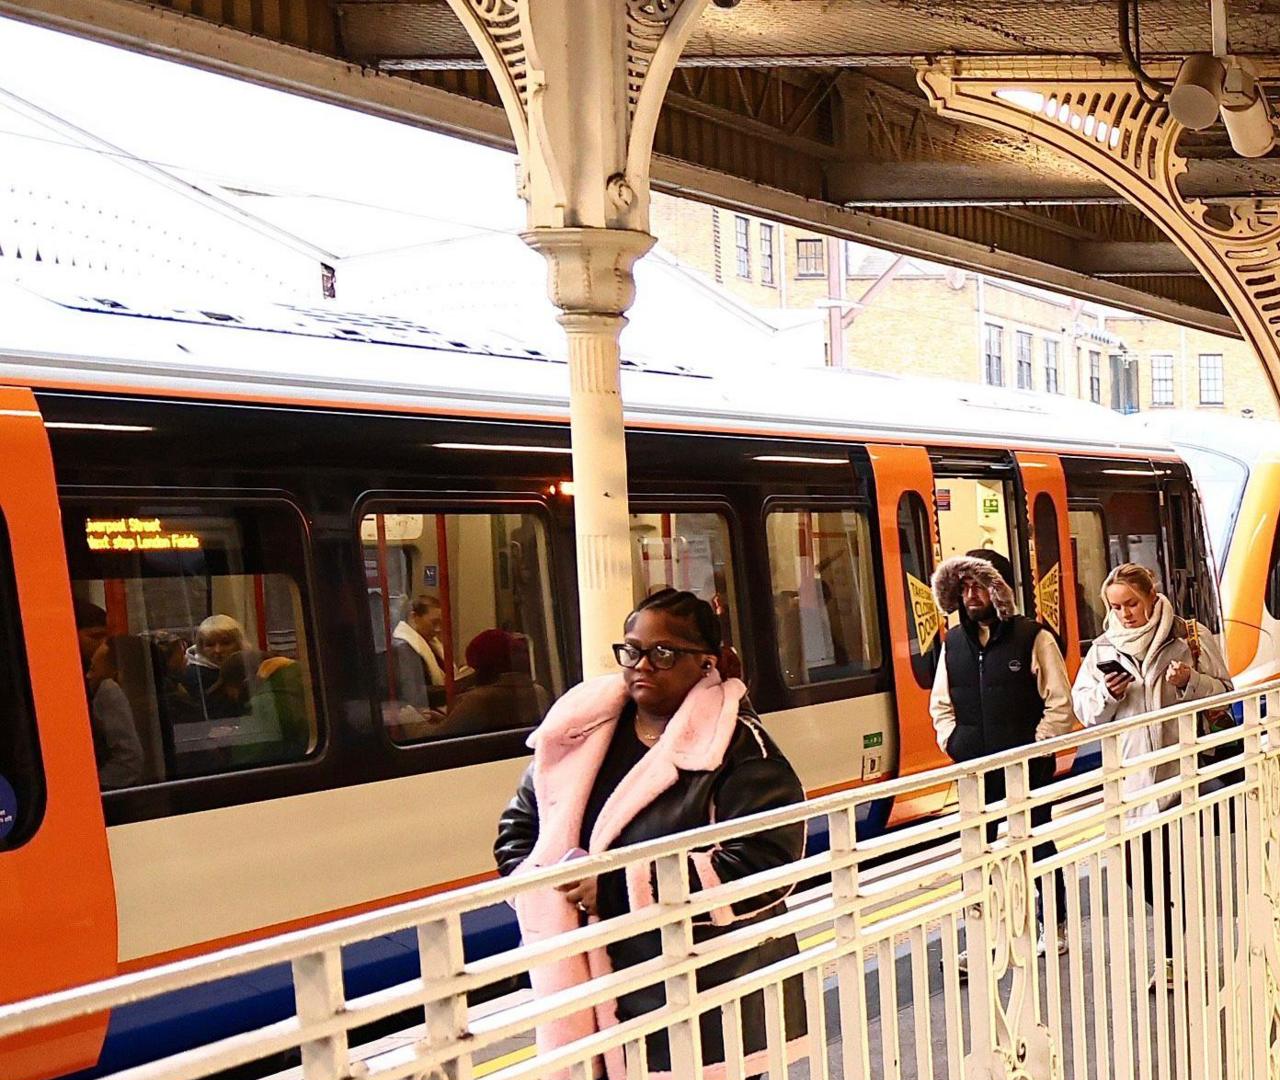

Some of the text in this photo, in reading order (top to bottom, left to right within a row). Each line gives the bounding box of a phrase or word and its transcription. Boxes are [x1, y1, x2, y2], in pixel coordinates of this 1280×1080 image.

[85, 517, 161, 534] iverpool Street
[112, 535, 135, 551] stop
[136, 534, 170, 549] London
[171, 534, 199, 548] Fields
